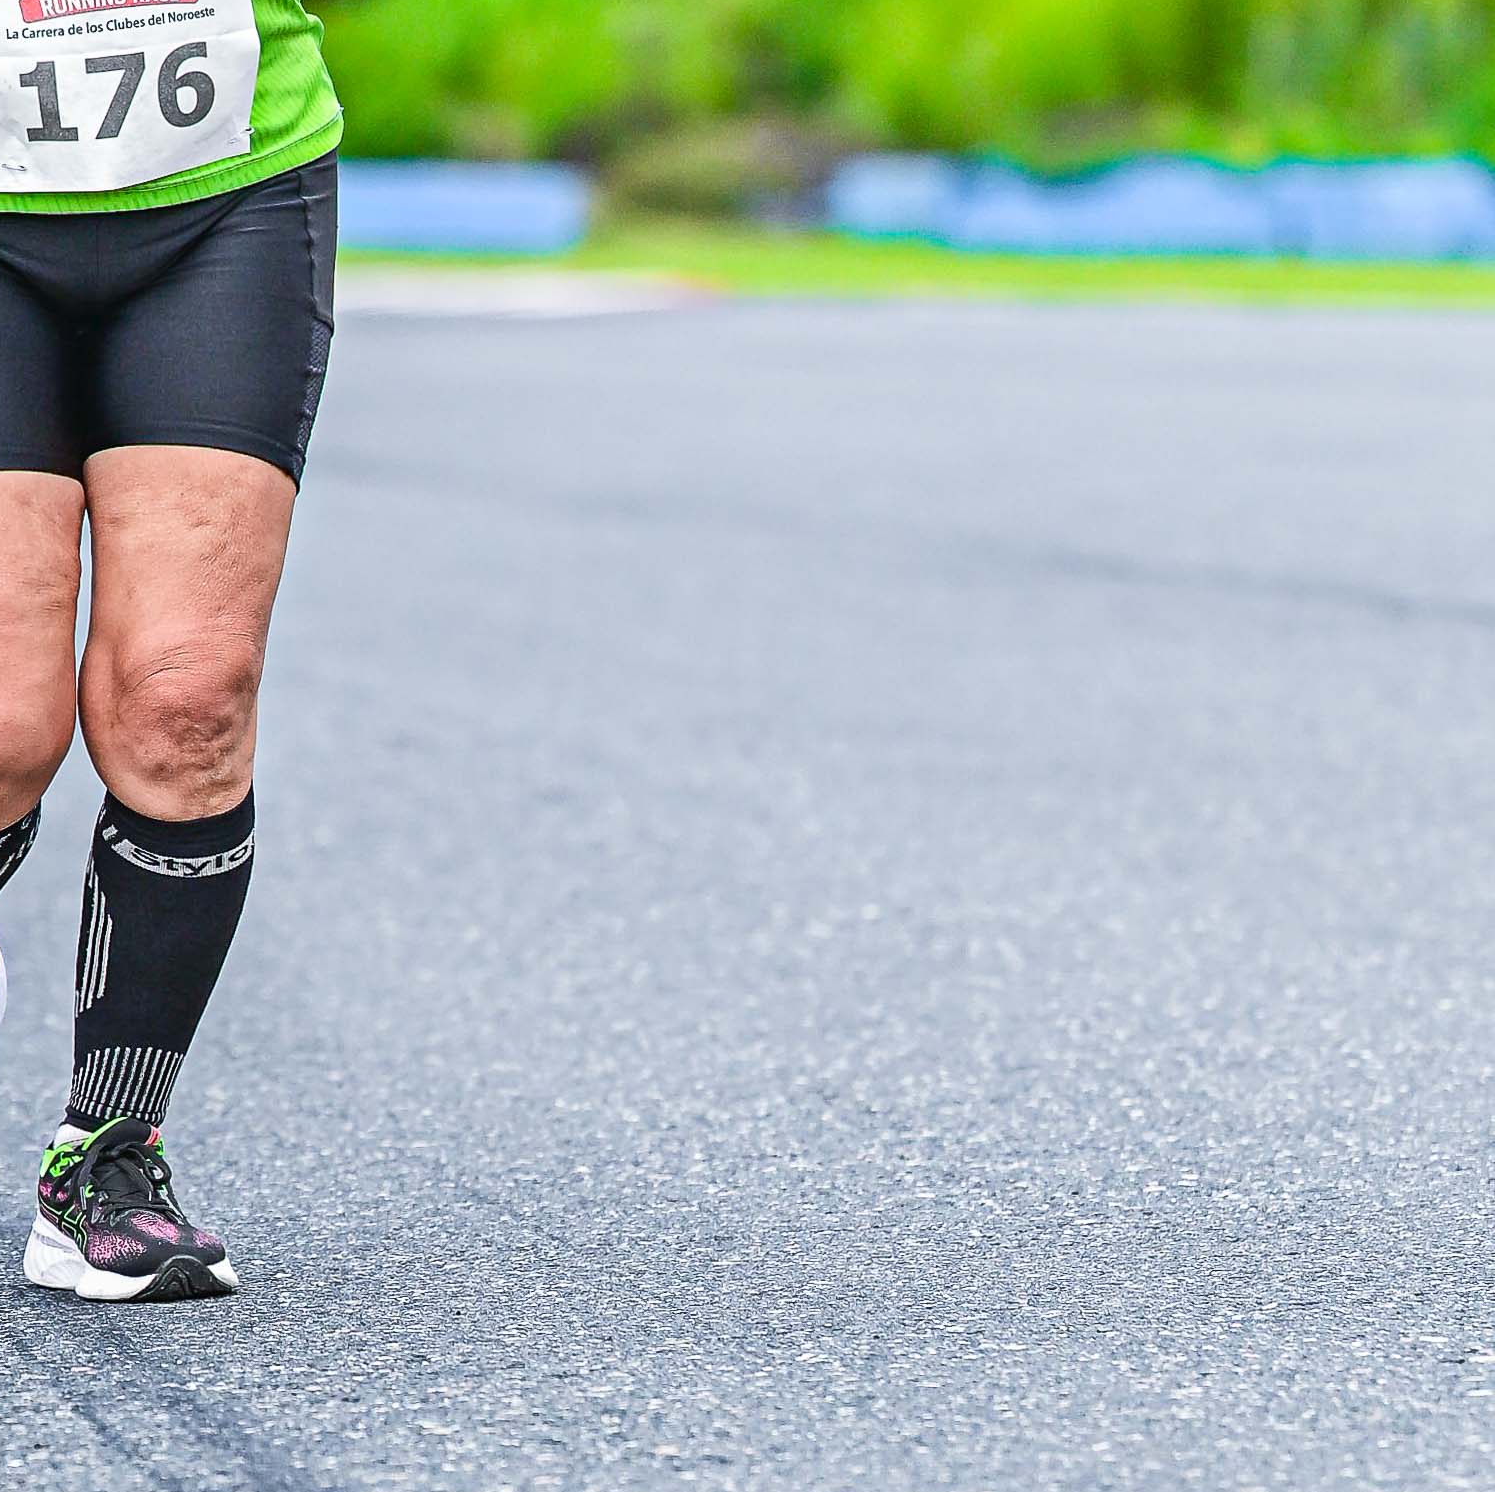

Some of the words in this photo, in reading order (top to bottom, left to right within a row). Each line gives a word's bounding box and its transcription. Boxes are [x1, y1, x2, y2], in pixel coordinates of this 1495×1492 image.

[6, 28, 19, 40] La
[21, 24, 65, 40] Carrera
[67, 23, 84, 36] de
[86, 20, 104, 34] los
[106, 15, 146, 32] Clubes
[147, 14, 166, 28] del
[167, 7, 215, 24] Noroeste
[19, 41, 215, 142] 176
